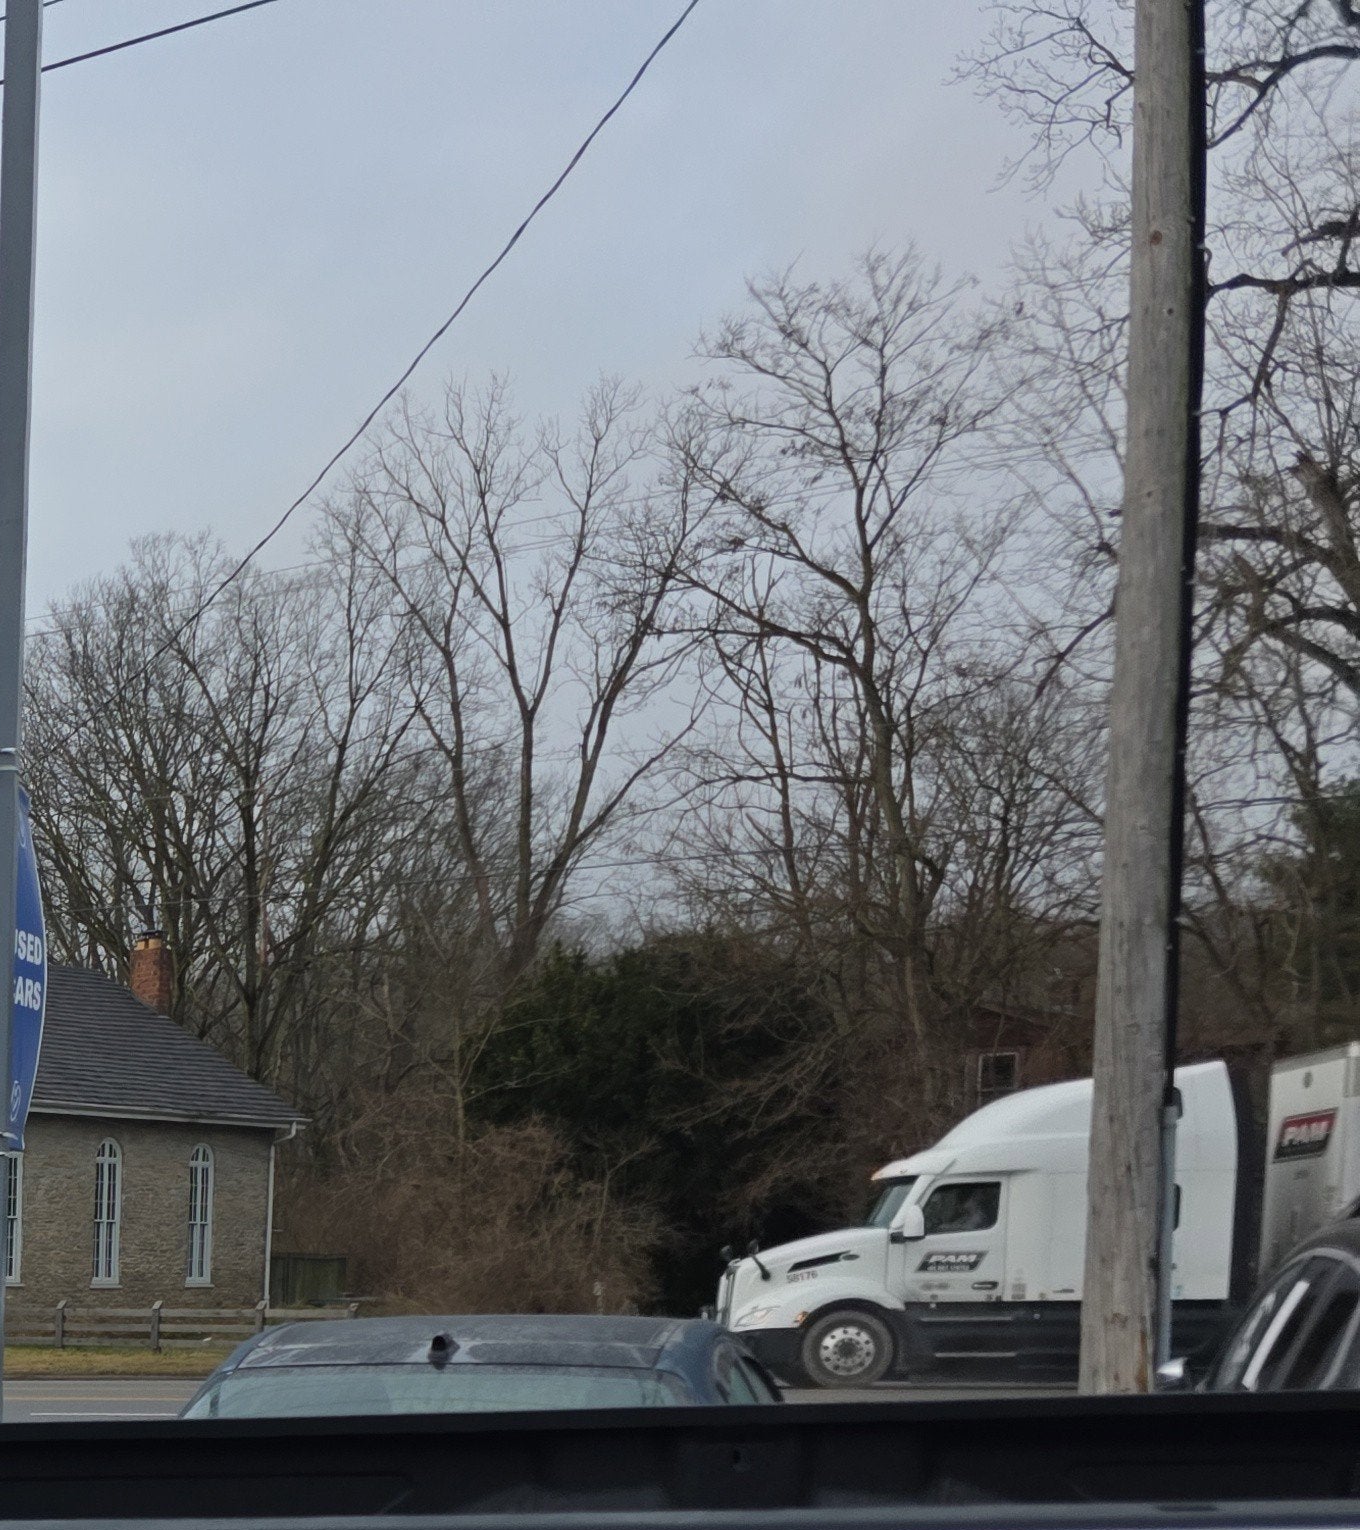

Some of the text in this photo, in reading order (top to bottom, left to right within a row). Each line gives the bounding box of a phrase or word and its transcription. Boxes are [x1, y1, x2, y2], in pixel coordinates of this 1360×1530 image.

[13, 976, 42, 1011] ARS
[1281, 1120, 1331, 1148] PAM
[929, 1254, 978, 1263] PAM
